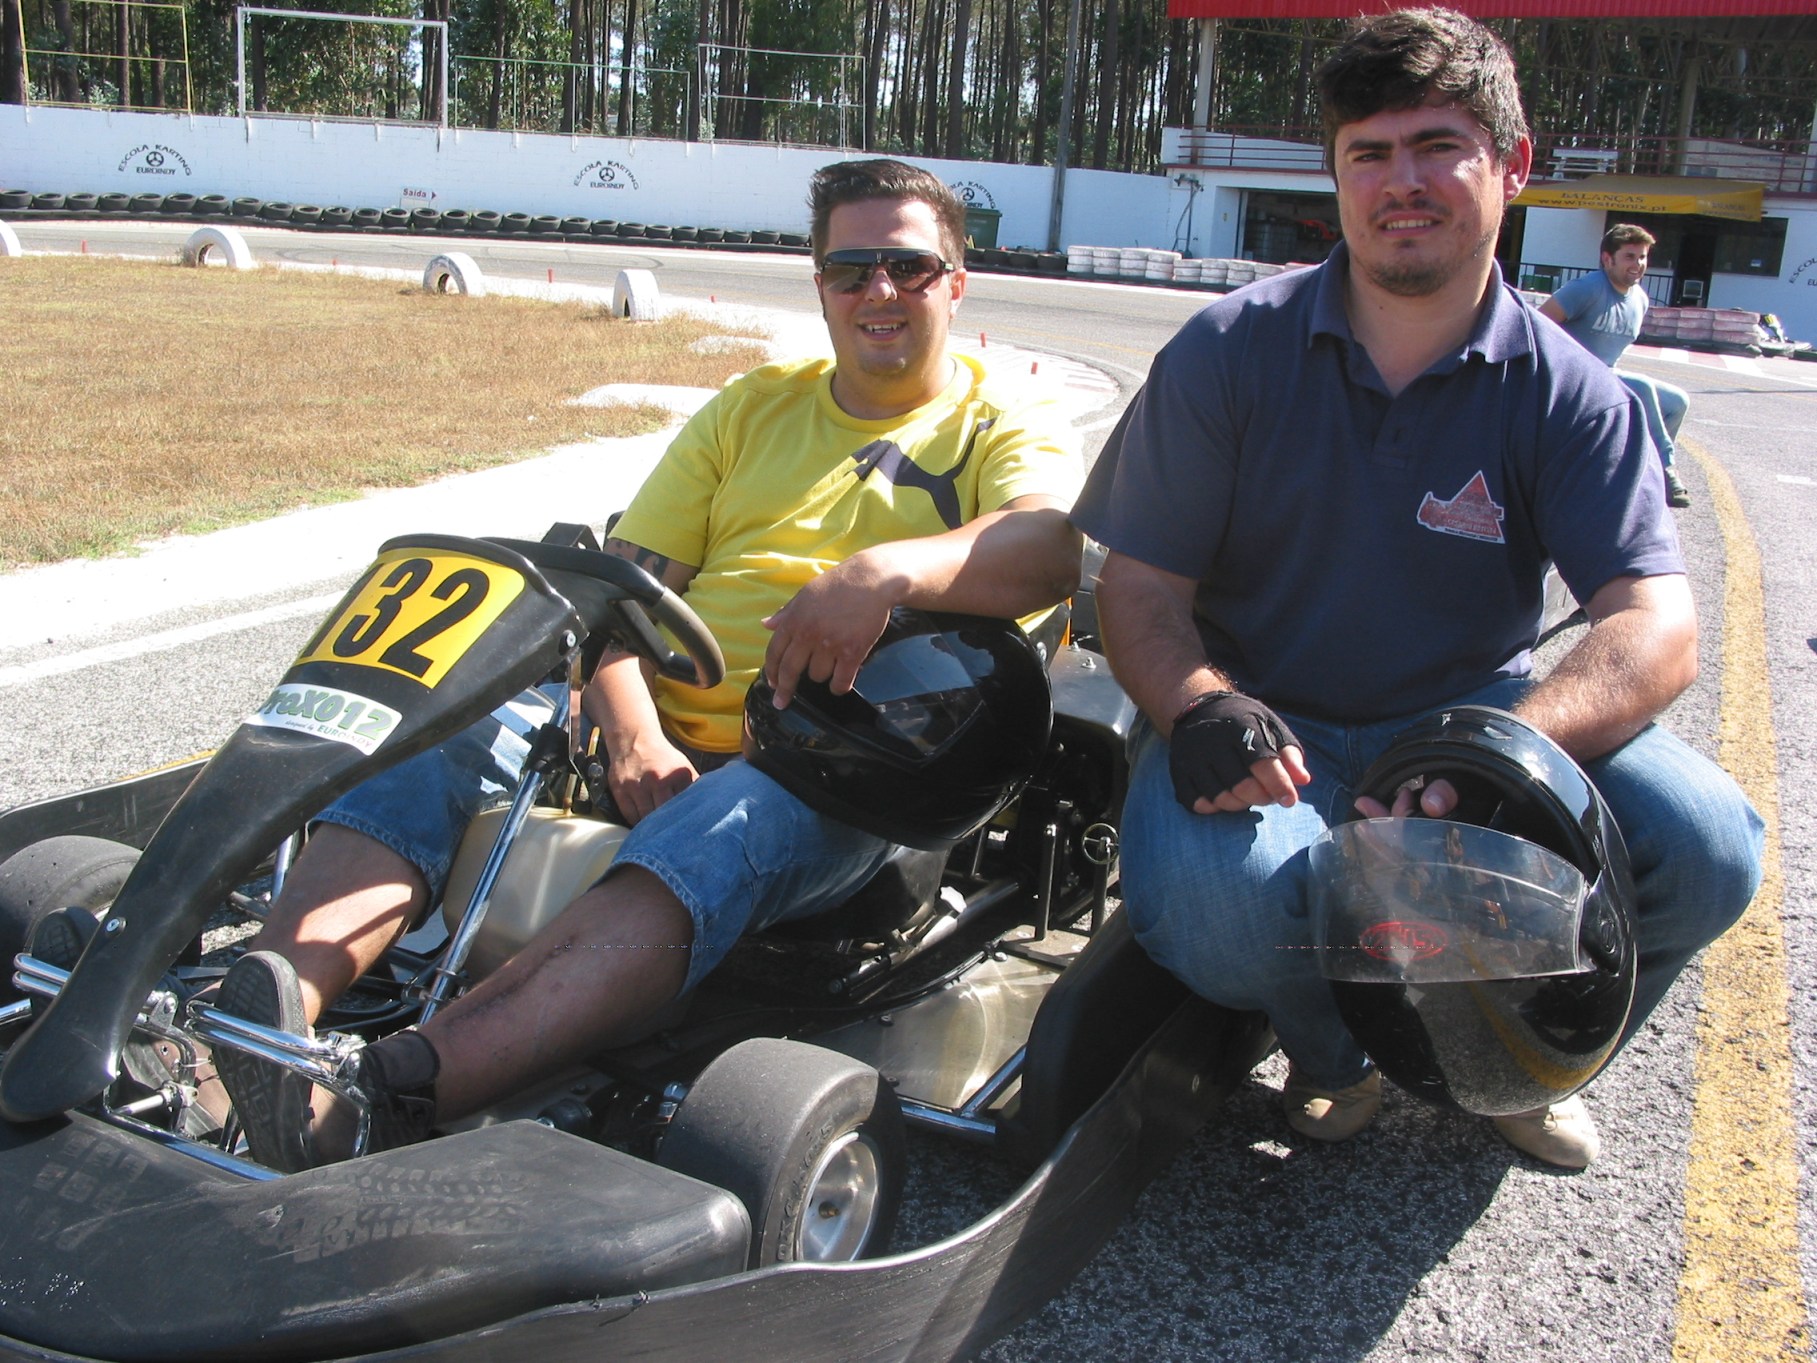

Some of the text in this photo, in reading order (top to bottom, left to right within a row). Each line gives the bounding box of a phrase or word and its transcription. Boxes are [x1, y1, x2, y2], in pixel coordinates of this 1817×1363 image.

[117, 144, 192, 176] ESCOLA KARTING
[573, 160, 639, 190] ESCOLA KARTING
[968, 181, 996, 209] KARTING
[1788, 257, 1817, 284] ESCOL
[316, 725, 373, 748] EUROINDY
